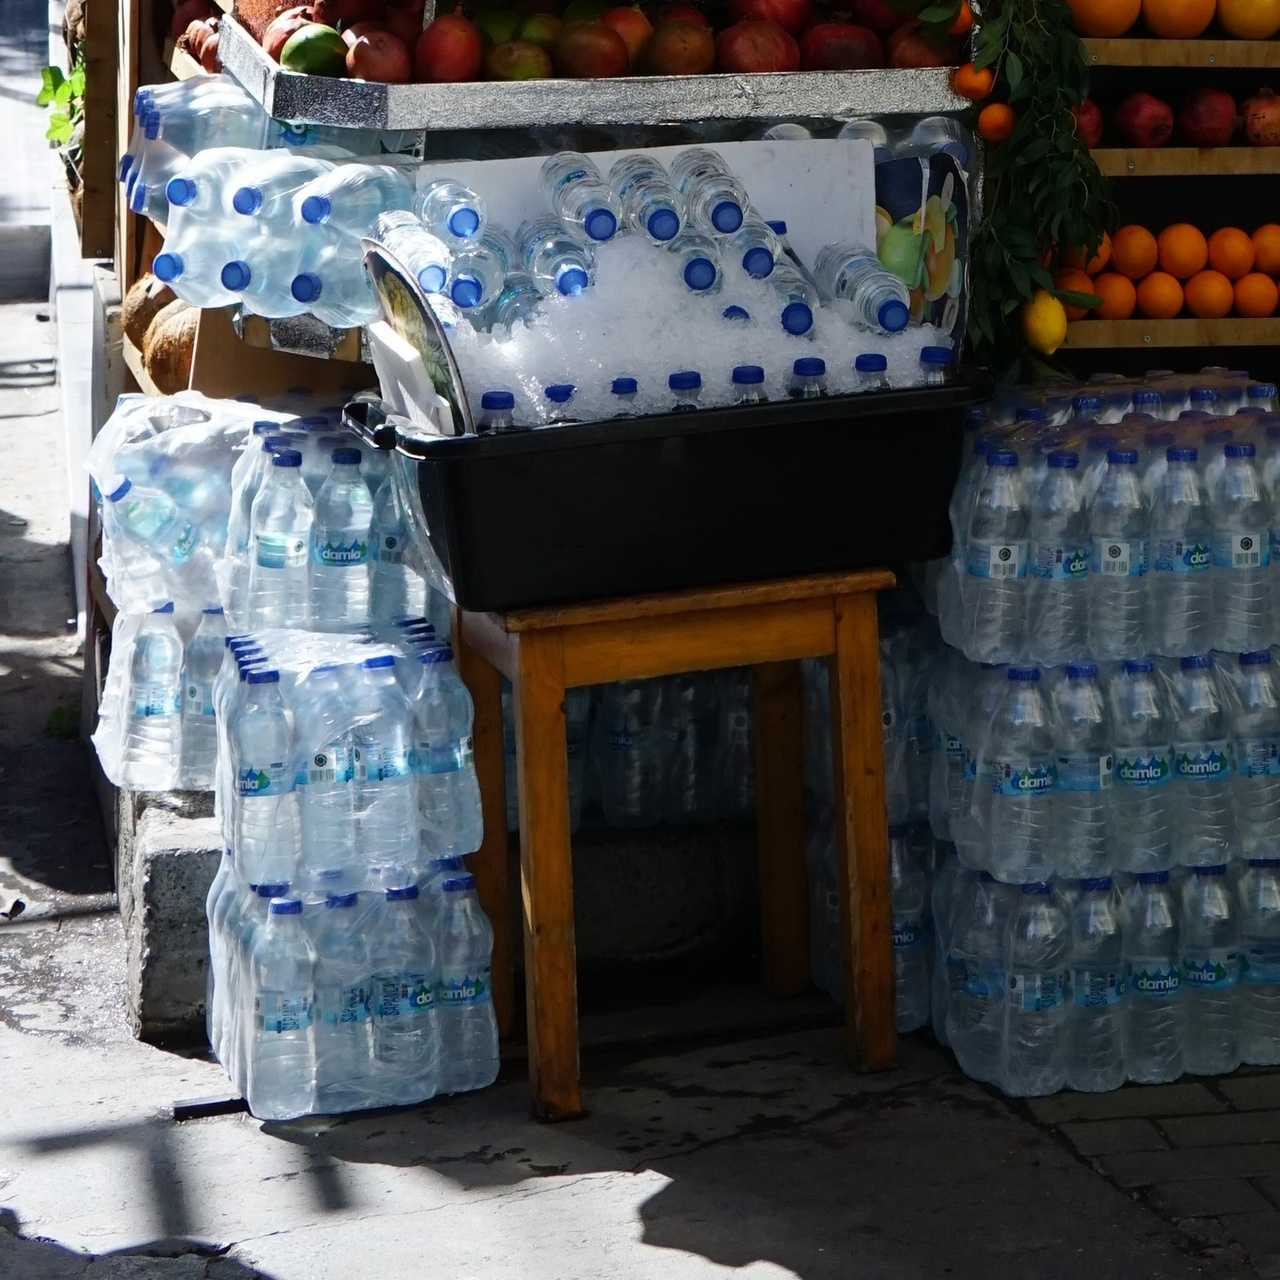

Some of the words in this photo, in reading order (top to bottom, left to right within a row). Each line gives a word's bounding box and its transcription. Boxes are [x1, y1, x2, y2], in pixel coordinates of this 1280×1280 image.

[322, 549, 361, 561] damla
[1120, 766, 1161, 779] damla
[1180, 760, 1221, 774] damla
[1137, 975, 1179, 991] damla
